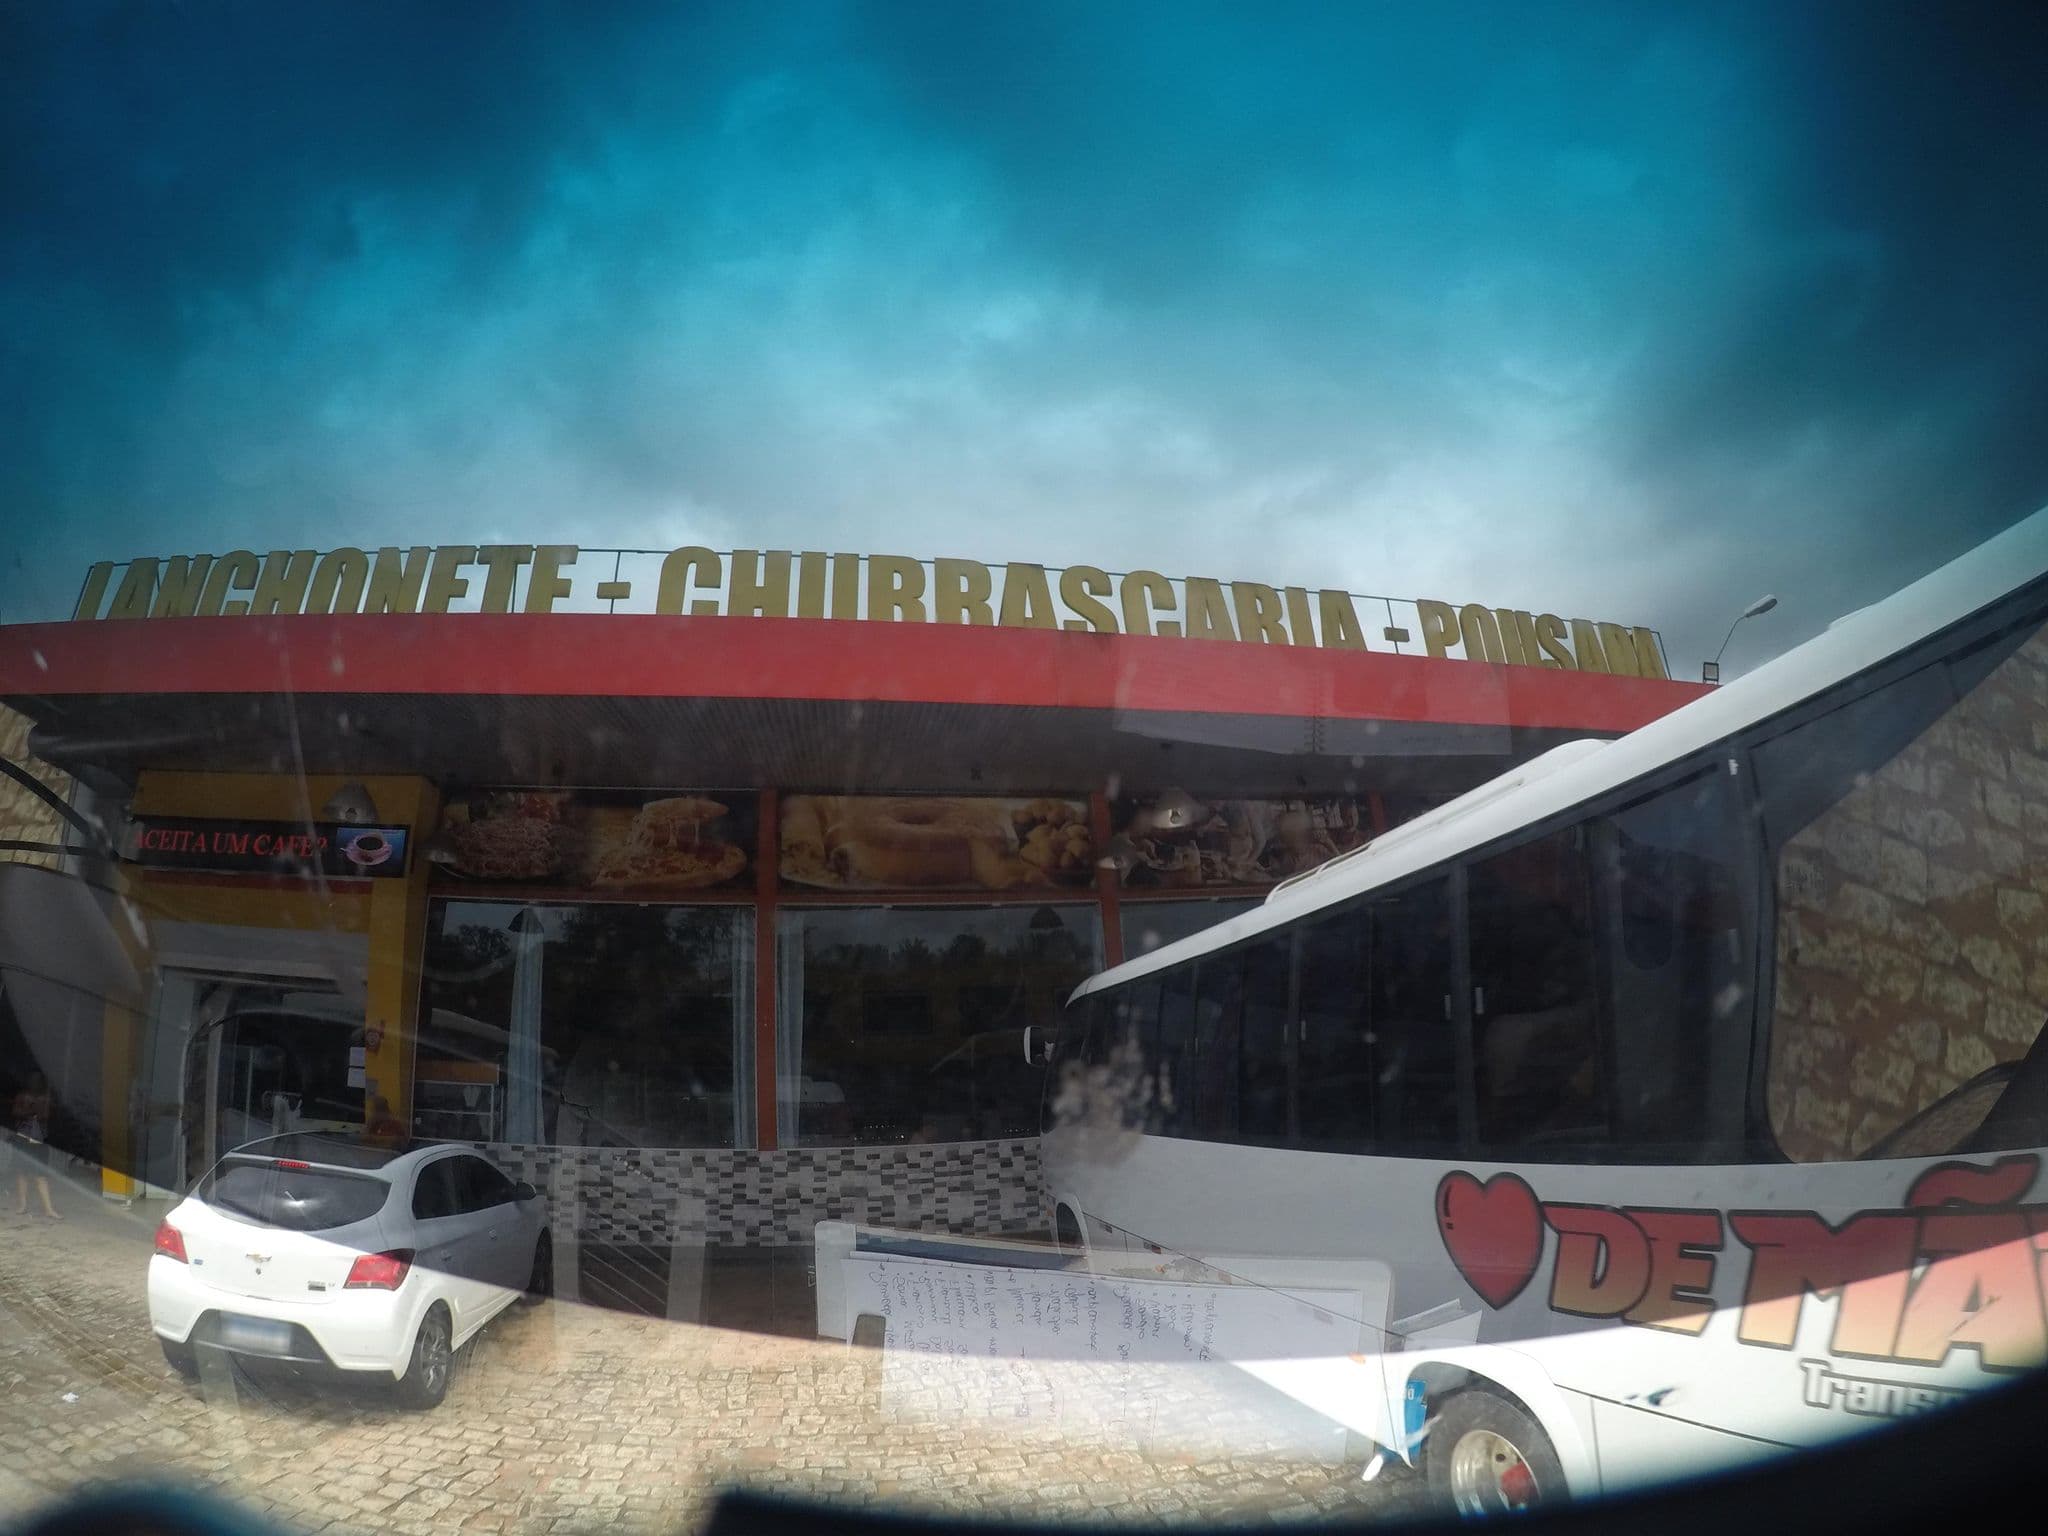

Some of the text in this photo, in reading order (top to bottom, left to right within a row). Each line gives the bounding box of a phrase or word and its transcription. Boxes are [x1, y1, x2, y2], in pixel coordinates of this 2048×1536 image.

[74, 545, 579, 620] LANCHONETE
[656, 546, 1368, 652] CHURRASCARIA
[1417, 599, 1667, 680] POUSADA
[213, 831, 249, 855] UM
[1541, 1153, 2048, 1374] DE MÃ
